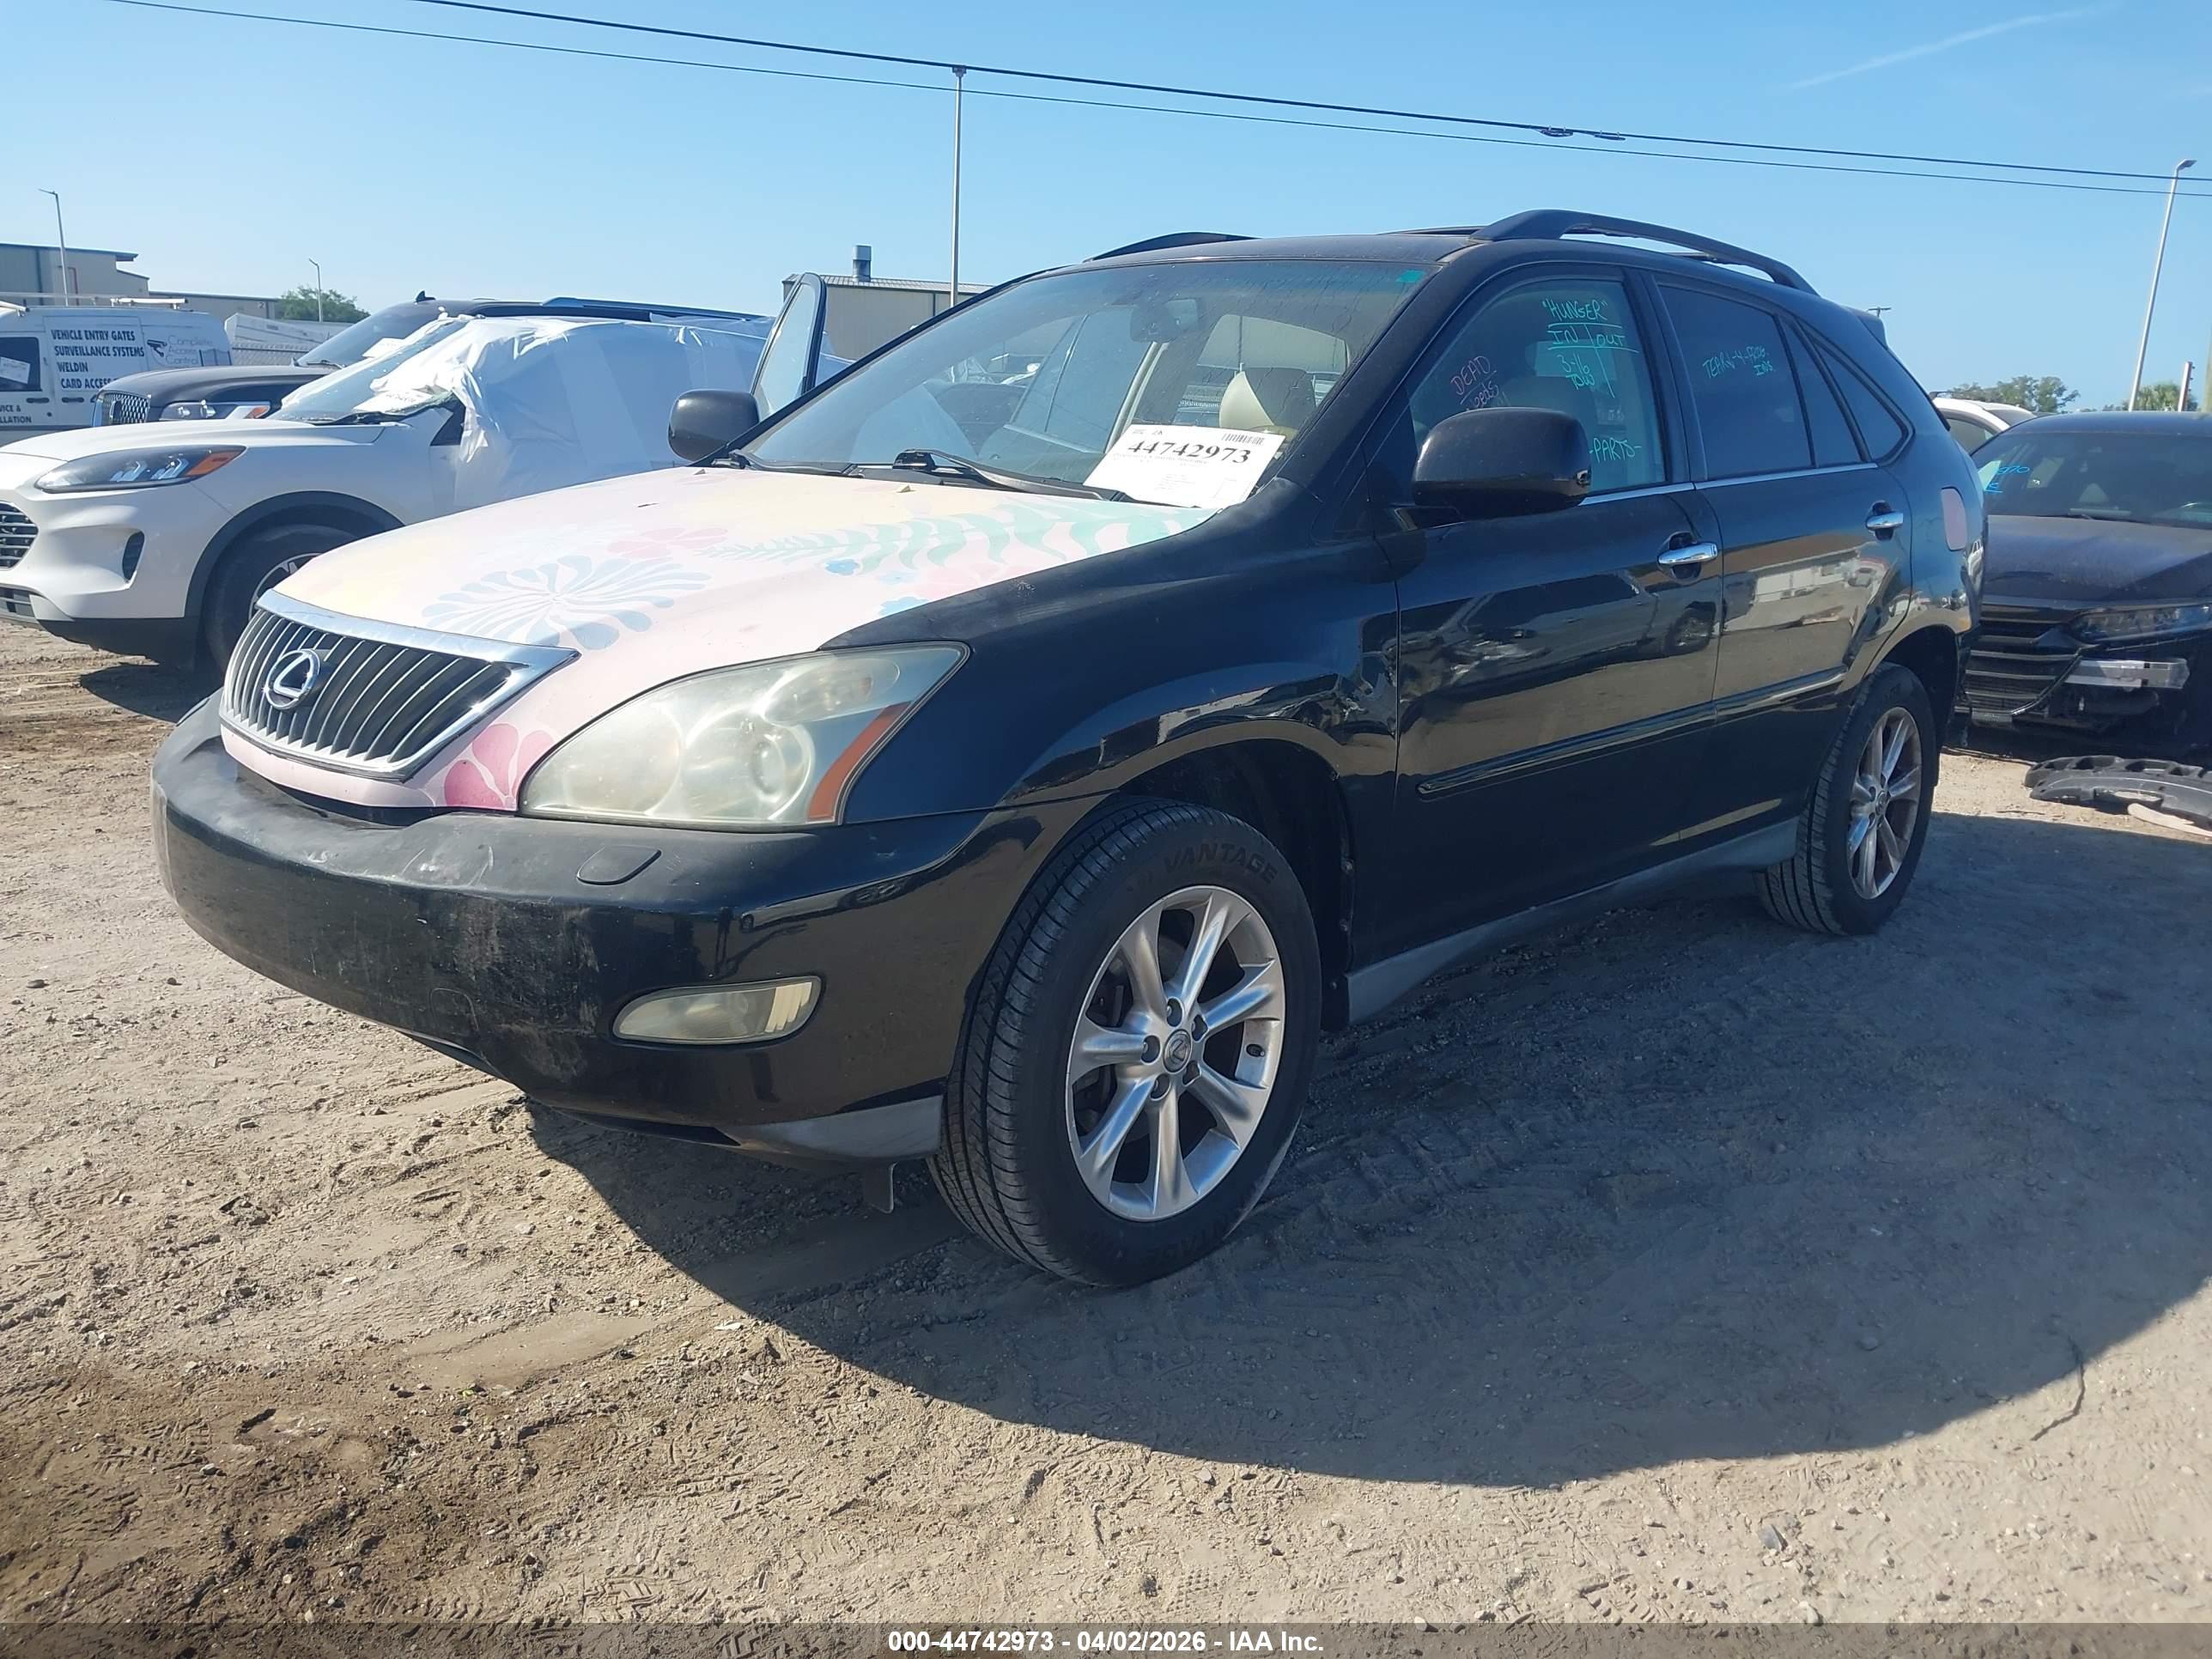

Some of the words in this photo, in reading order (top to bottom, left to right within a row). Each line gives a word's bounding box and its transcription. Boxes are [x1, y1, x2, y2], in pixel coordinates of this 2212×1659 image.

[51, 329, 83, 341] VEHICLE
[84, 329, 109, 341] ENTRY
[111, 330, 136, 341] GATES
[1547, 325, 1579, 345] IN
[1595, 333, 1626, 347] OUT
[54, 345, 112, 356] SURVEILLANCE
[112, 346, 145, 357] SYSTEMS
[57, 362, 89, 373] WELDIN
[1556, 352, 1590, 375] 3-16
[61, 378, 82, 389] CARD
[1450, 356, 1491, 396] DEAD
[1565, 373, 1595, 390] TOW
[1127, 439, 1252, 464] 44742973
[1164, 842, 1279, 884] VANTAGE
